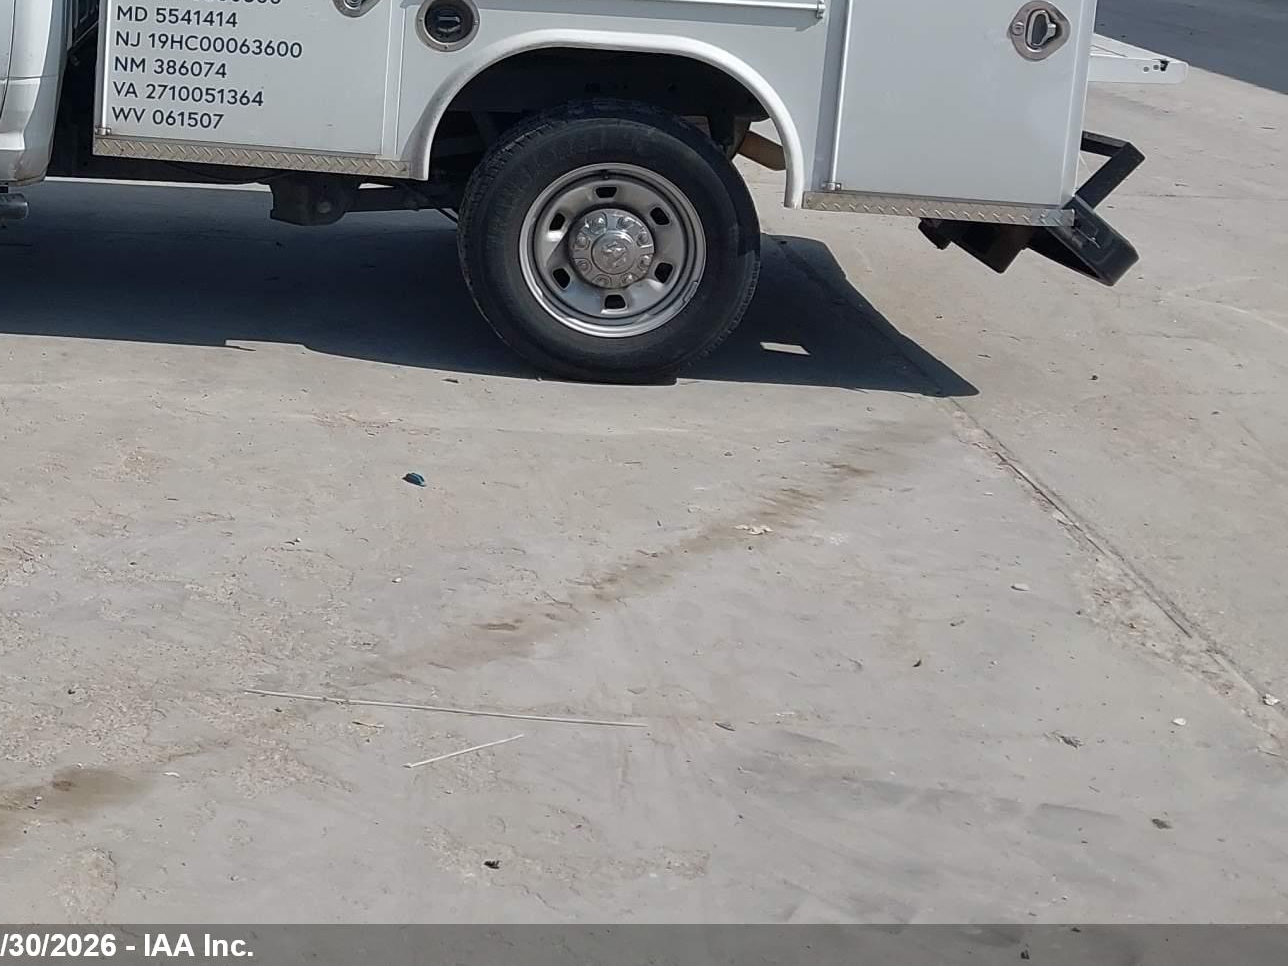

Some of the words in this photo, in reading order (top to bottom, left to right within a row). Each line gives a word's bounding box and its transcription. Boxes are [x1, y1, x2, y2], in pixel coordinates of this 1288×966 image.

[117, 6, 148, 22] MD
[155, 8, 238, 28] 5541414
[116, 31, 141, 48] NJ
[148, 33, 303, 59] 19HC00063600
[114, 56, 146, 74] NM
[153, 59, 227, 79] 386074
[113, 81, 139, 99] VA
[145, 84, 264, 107] 2710051364
[112, 107, 146, 124] WV
[152, 110, 224, 130] 061507
